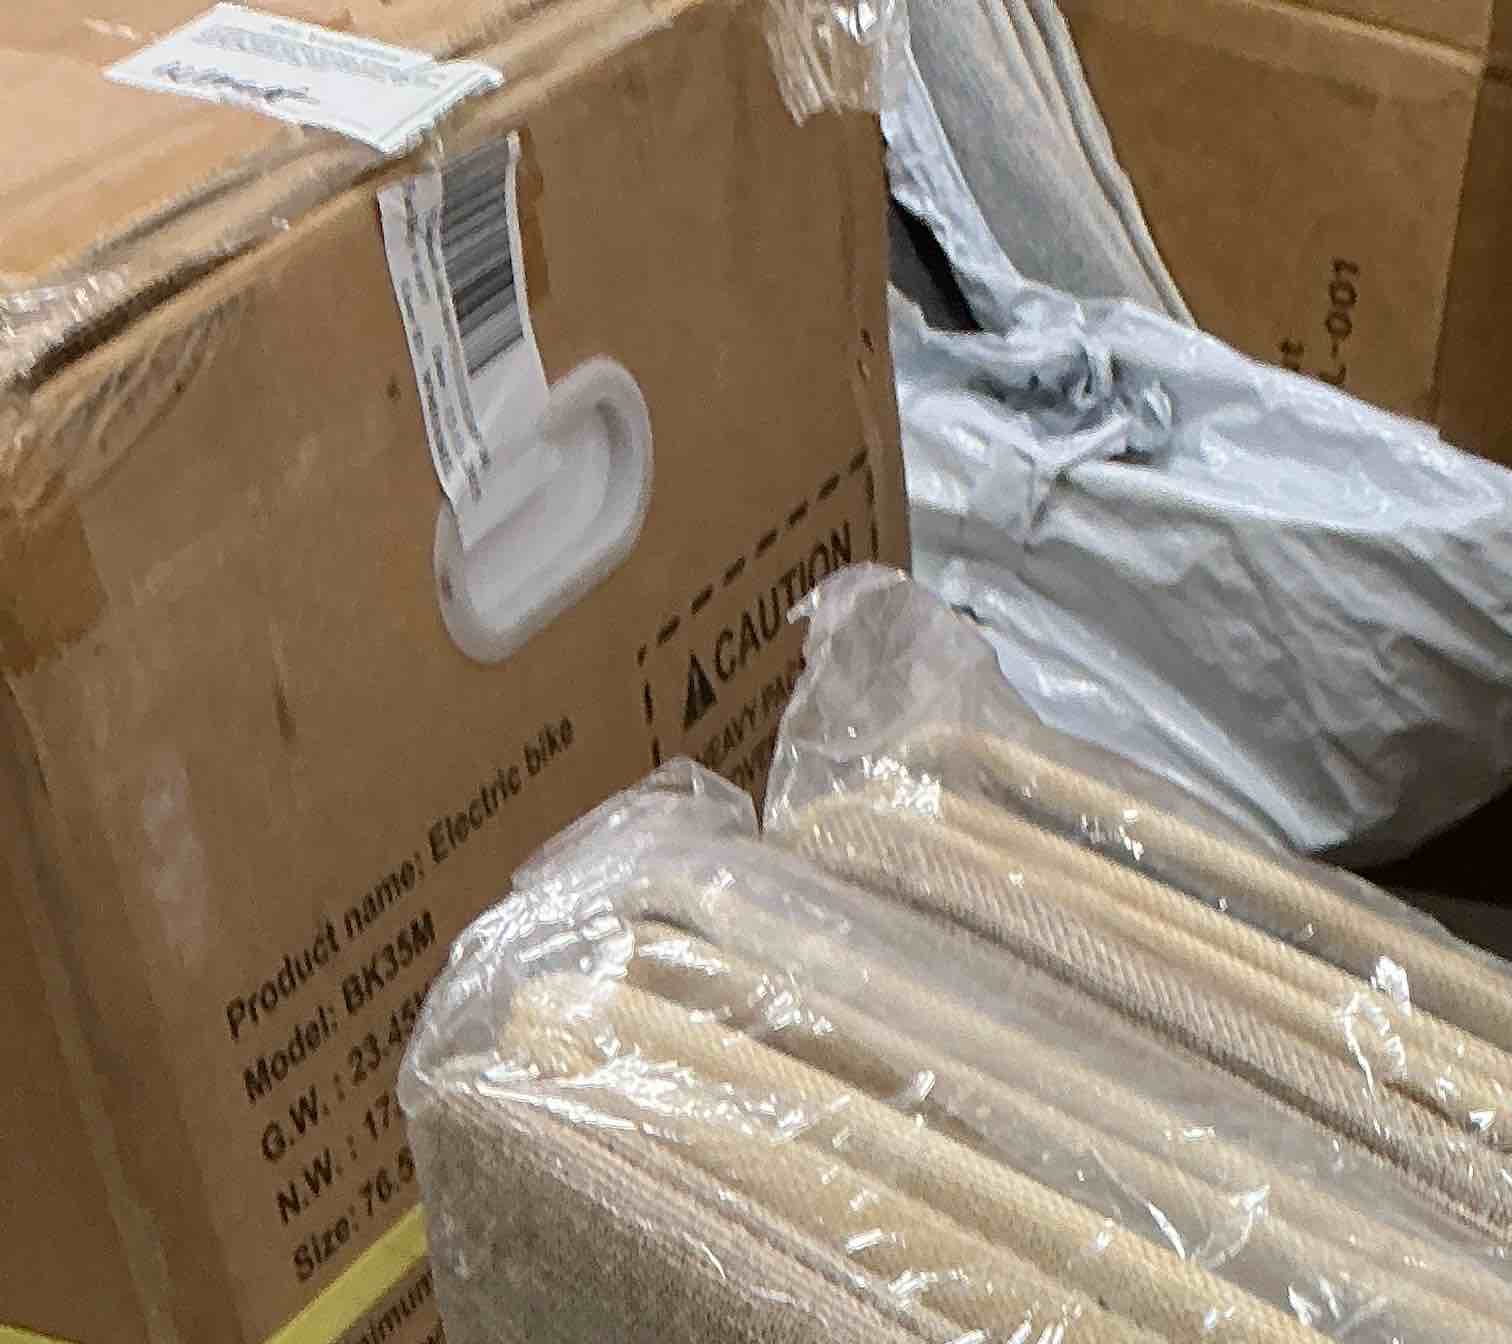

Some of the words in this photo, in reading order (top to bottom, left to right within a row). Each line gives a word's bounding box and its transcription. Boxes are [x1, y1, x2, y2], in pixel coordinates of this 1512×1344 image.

[714, 521, 853, 682] CAUTION
[225, 918, 342, 1042] Product
[343, 851, 426, 938] name:
[427, 765, 523, 865] Electric
[523, 715, 575, 778] bike
[243, 1004, 342, 1102] Model:
